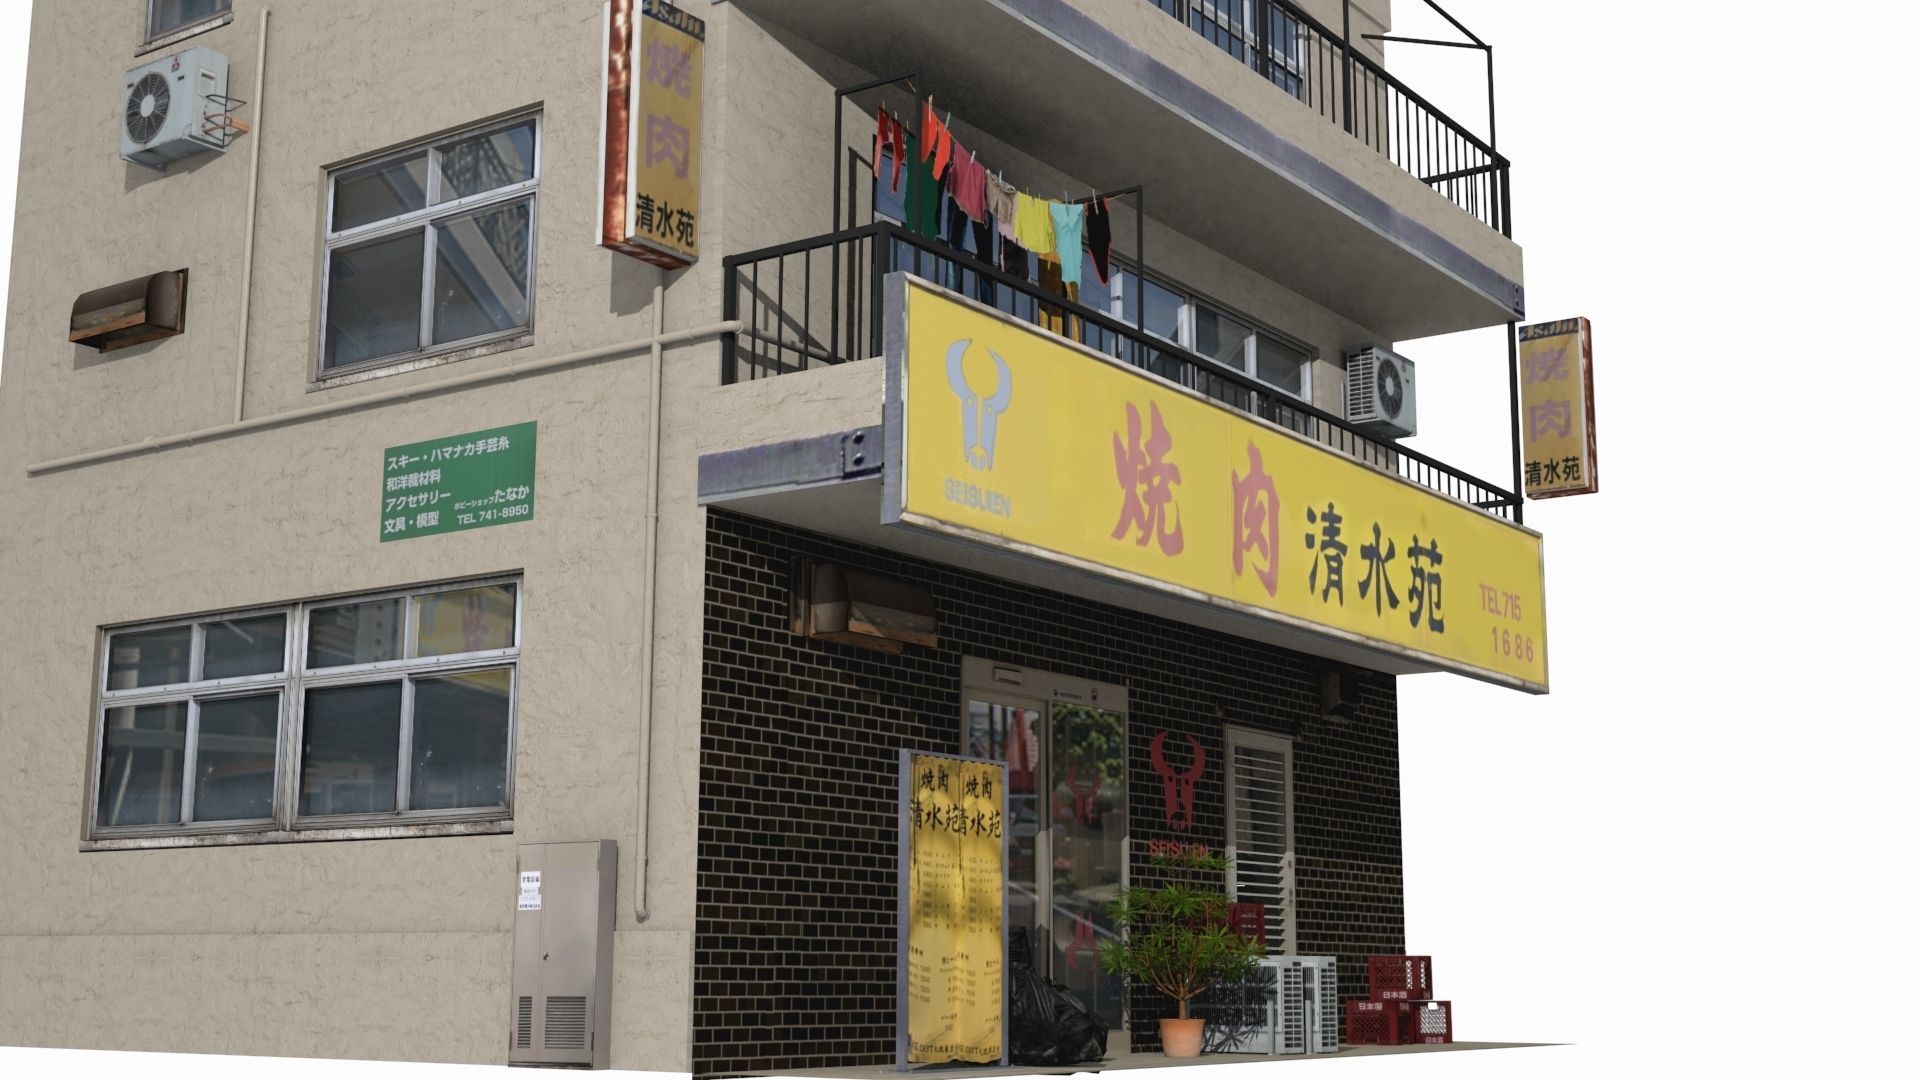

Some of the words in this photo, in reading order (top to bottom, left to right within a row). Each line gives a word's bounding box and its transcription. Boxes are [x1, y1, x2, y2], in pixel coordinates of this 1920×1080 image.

[646, 38, 692, 181] 焼肉
[636, 193, 694, 248] 清水苑
[1526, 346, 1572, 443] 焼肉
[1525, 456, 1581, 487] 清水苑
[385, 490, 452, 513] アクセサリー
[457, 513, 477, 525] TEL
[479, 504, 529, 522] 741-8950
[1305, 501, 1445, 635] 清水苑
[1492, 626, 1534, 663] 1686
